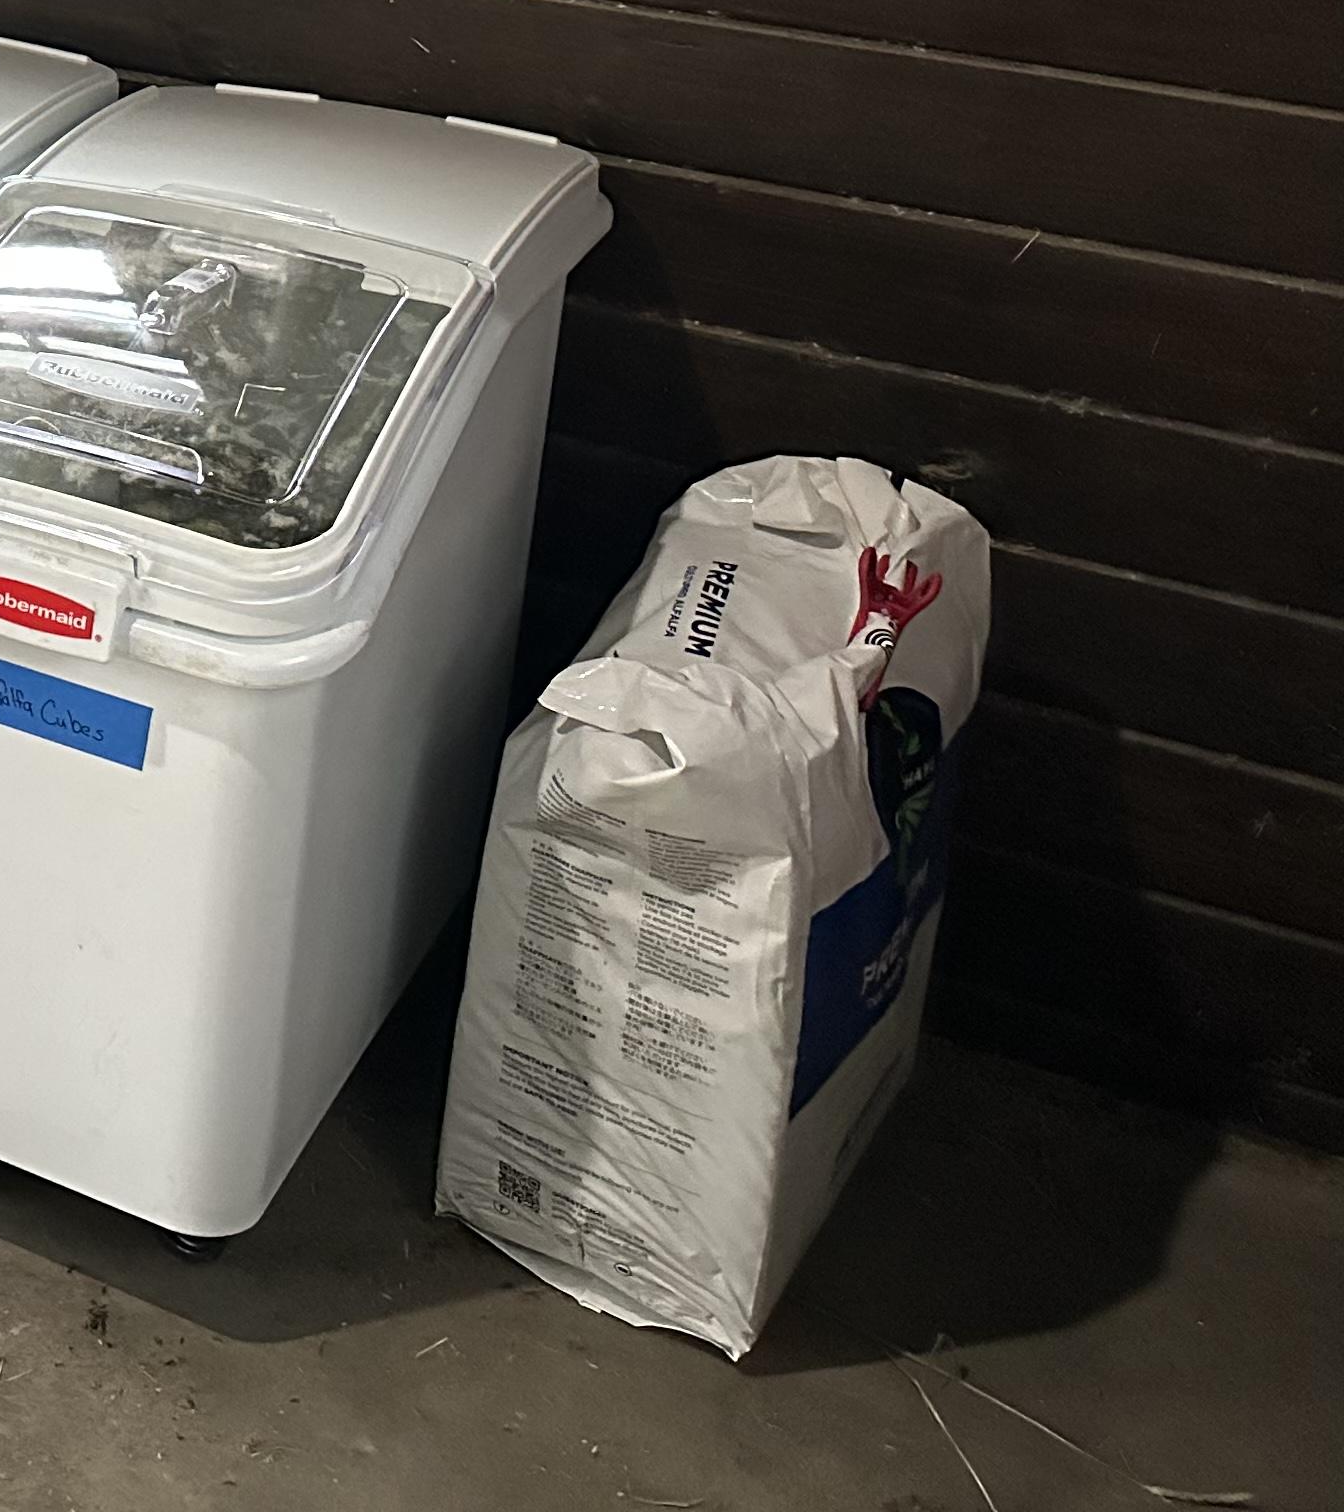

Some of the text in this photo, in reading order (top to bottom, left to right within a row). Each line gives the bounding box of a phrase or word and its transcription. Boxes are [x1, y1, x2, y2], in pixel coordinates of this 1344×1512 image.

[38, 360, 189, 405] Rubbermaid
[664, 599, 685, 638] ALFALFA
[684, 560, 739, 658] PREMIUM
[40, 699, 104, 742] Cubes
